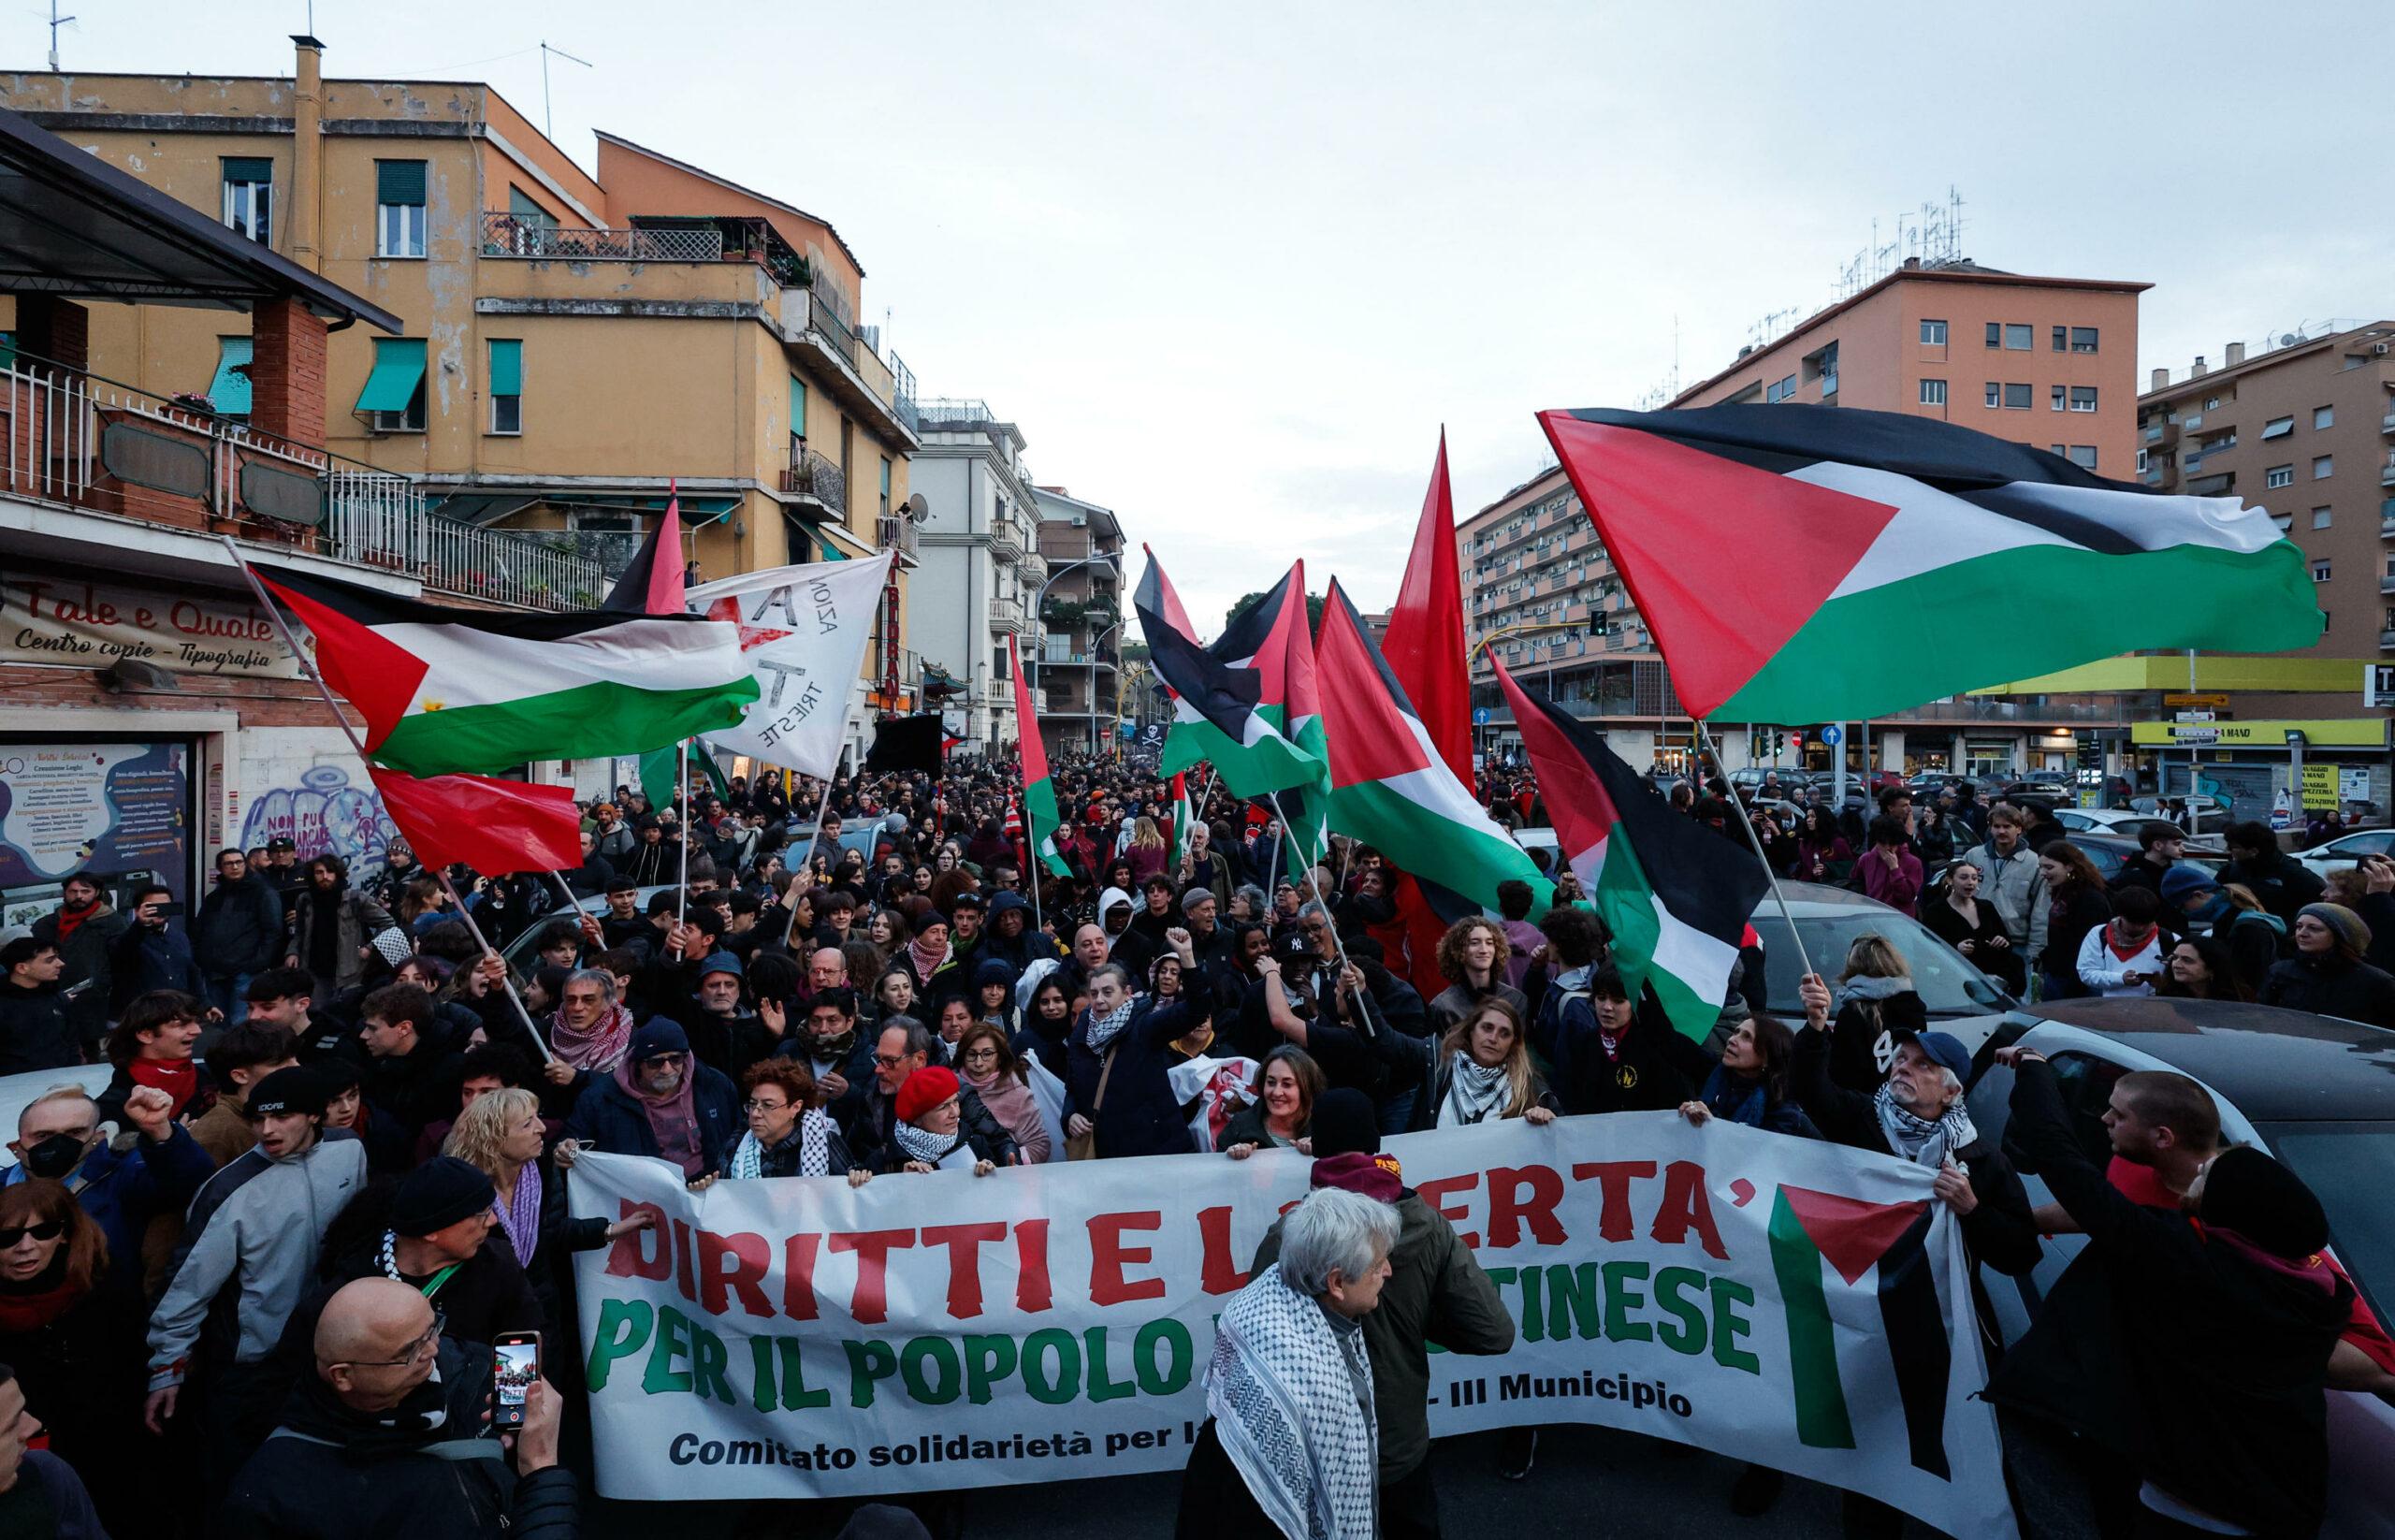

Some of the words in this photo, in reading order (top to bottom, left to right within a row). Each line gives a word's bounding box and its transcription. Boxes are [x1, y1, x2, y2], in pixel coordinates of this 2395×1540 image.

[9, 581, 122, 626] Tale
[135, 605, 157, 631] e
[170, 600, 274, 642] Quale
[15, 628, 94, 654] Centro
[99, 640, 156, 660] copie
[179, 642, 271, 672] Tipografia
[2227, 728, 2251, 737] MANO
[268, 815, 296, 831] NON
[604, 1198, 1053, 1325] DIRITTI
[1085, 1211, 1166, 1307] E
[1197, 1159, 1757, 1296] LERTA'
[586, 1298, 737, 1405] PER
[749, 1334, 831, 1413] IL
[842, 1317, 1195, 1410] POPOLO
[669, 1432, 857, 1472] Comitato
[868, 1431, 1093, 1466] solidarietà
[1106, 1426, 1172, 1458] per
[1183, 1420, 1201, 1445] l
[1450, 1378, 1487, 1407] III
[1499, 1370, 1693, 1418] Municipio
